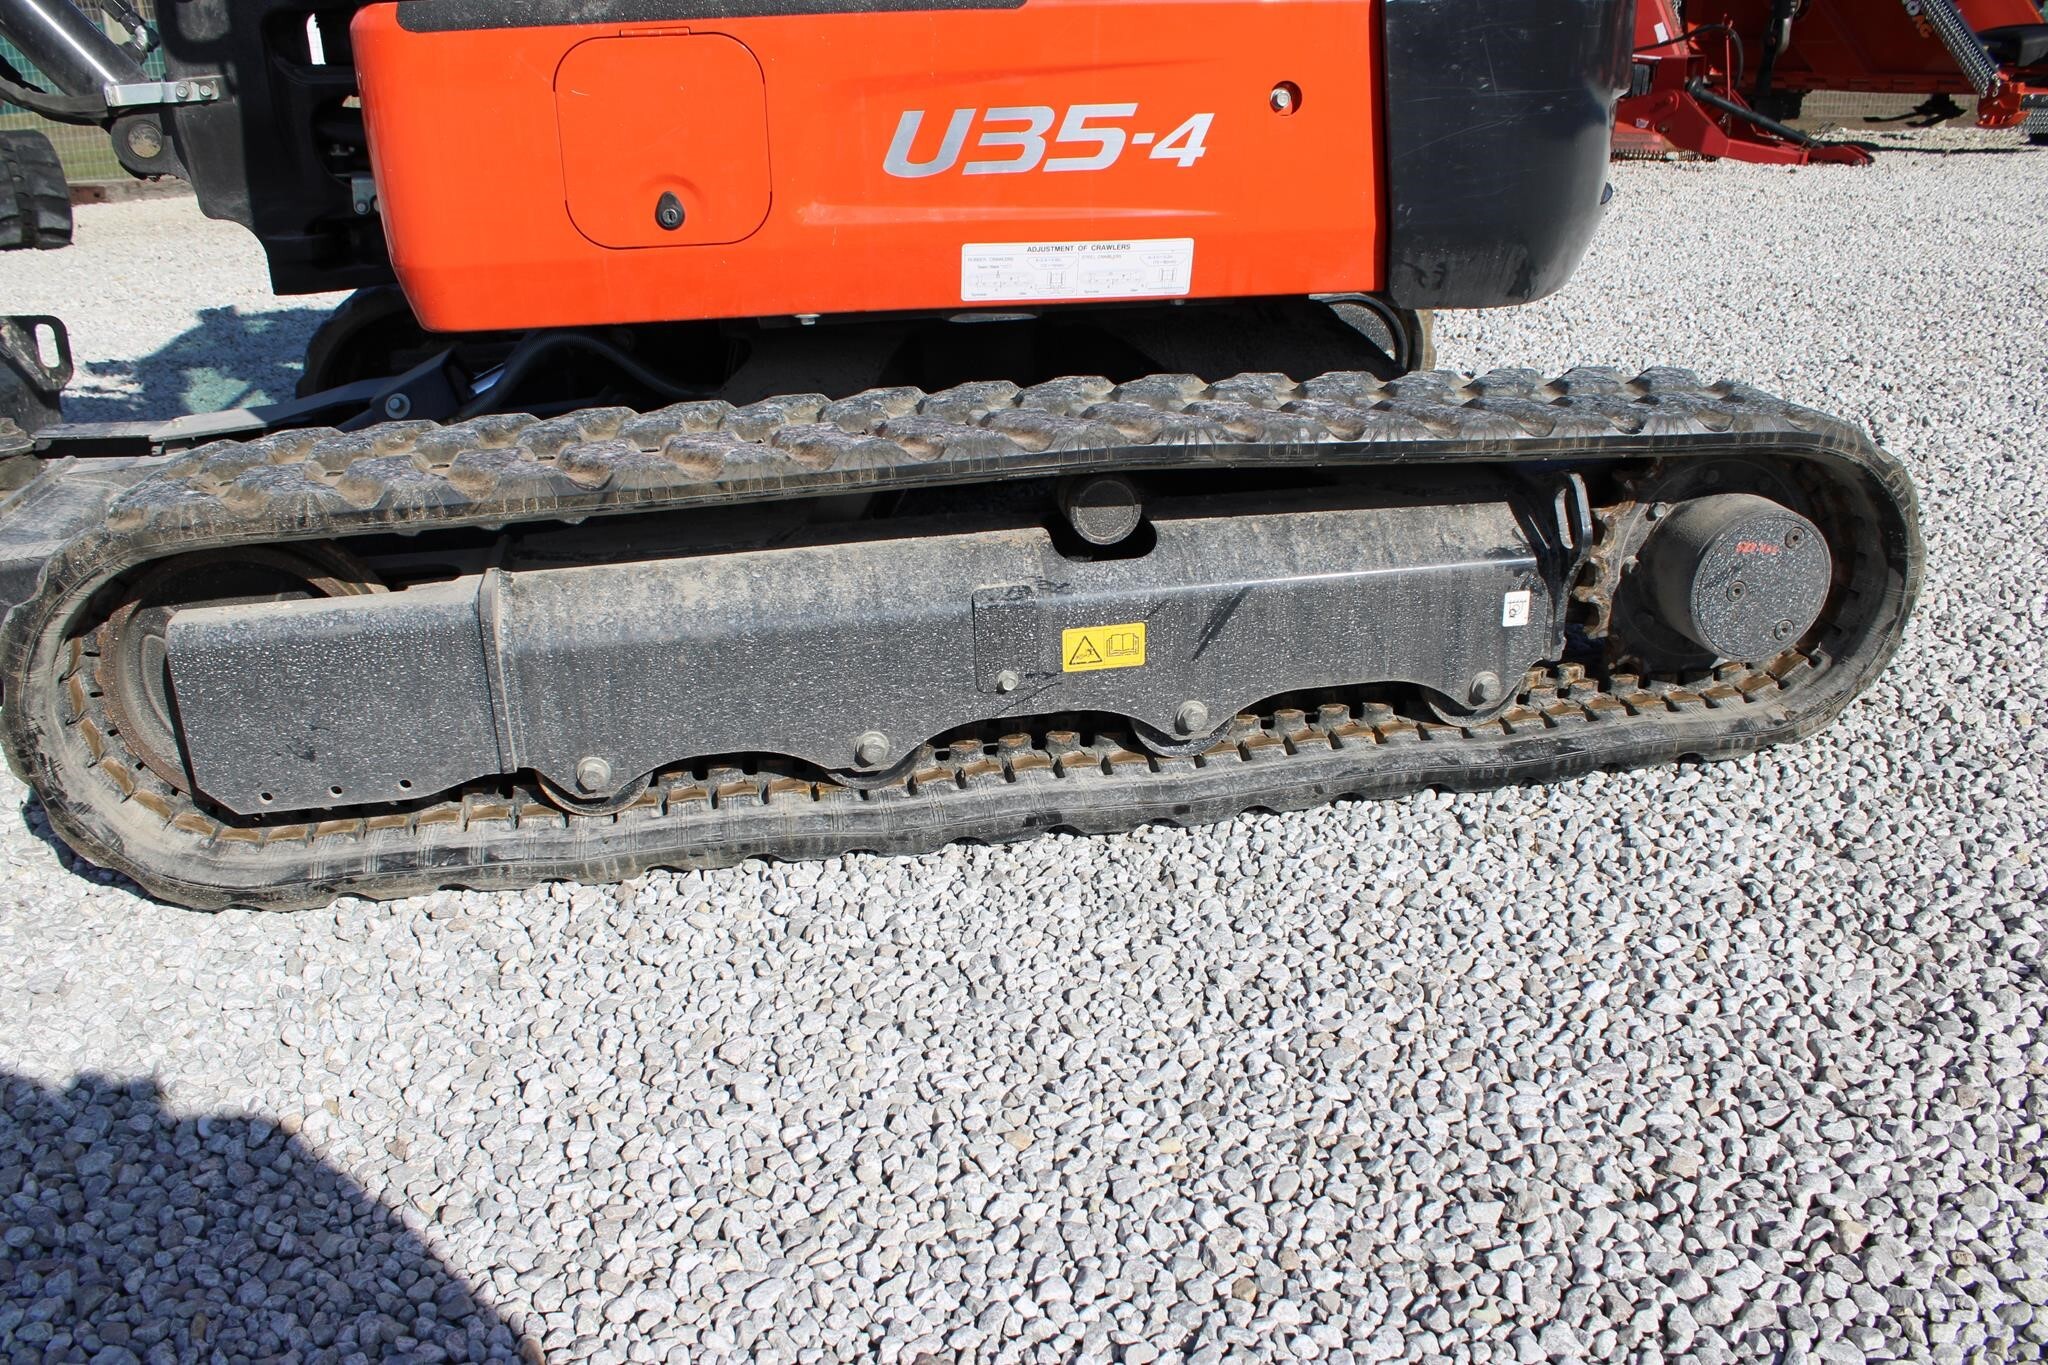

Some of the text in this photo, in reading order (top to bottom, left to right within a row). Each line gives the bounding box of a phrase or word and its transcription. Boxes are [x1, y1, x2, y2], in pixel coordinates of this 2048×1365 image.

[882, 102, 1215, 179] U35-4
[1026, 245, 1075, 253] ADJUSTMENT
[1090, 243, 1131, 251] CRAWLERS
